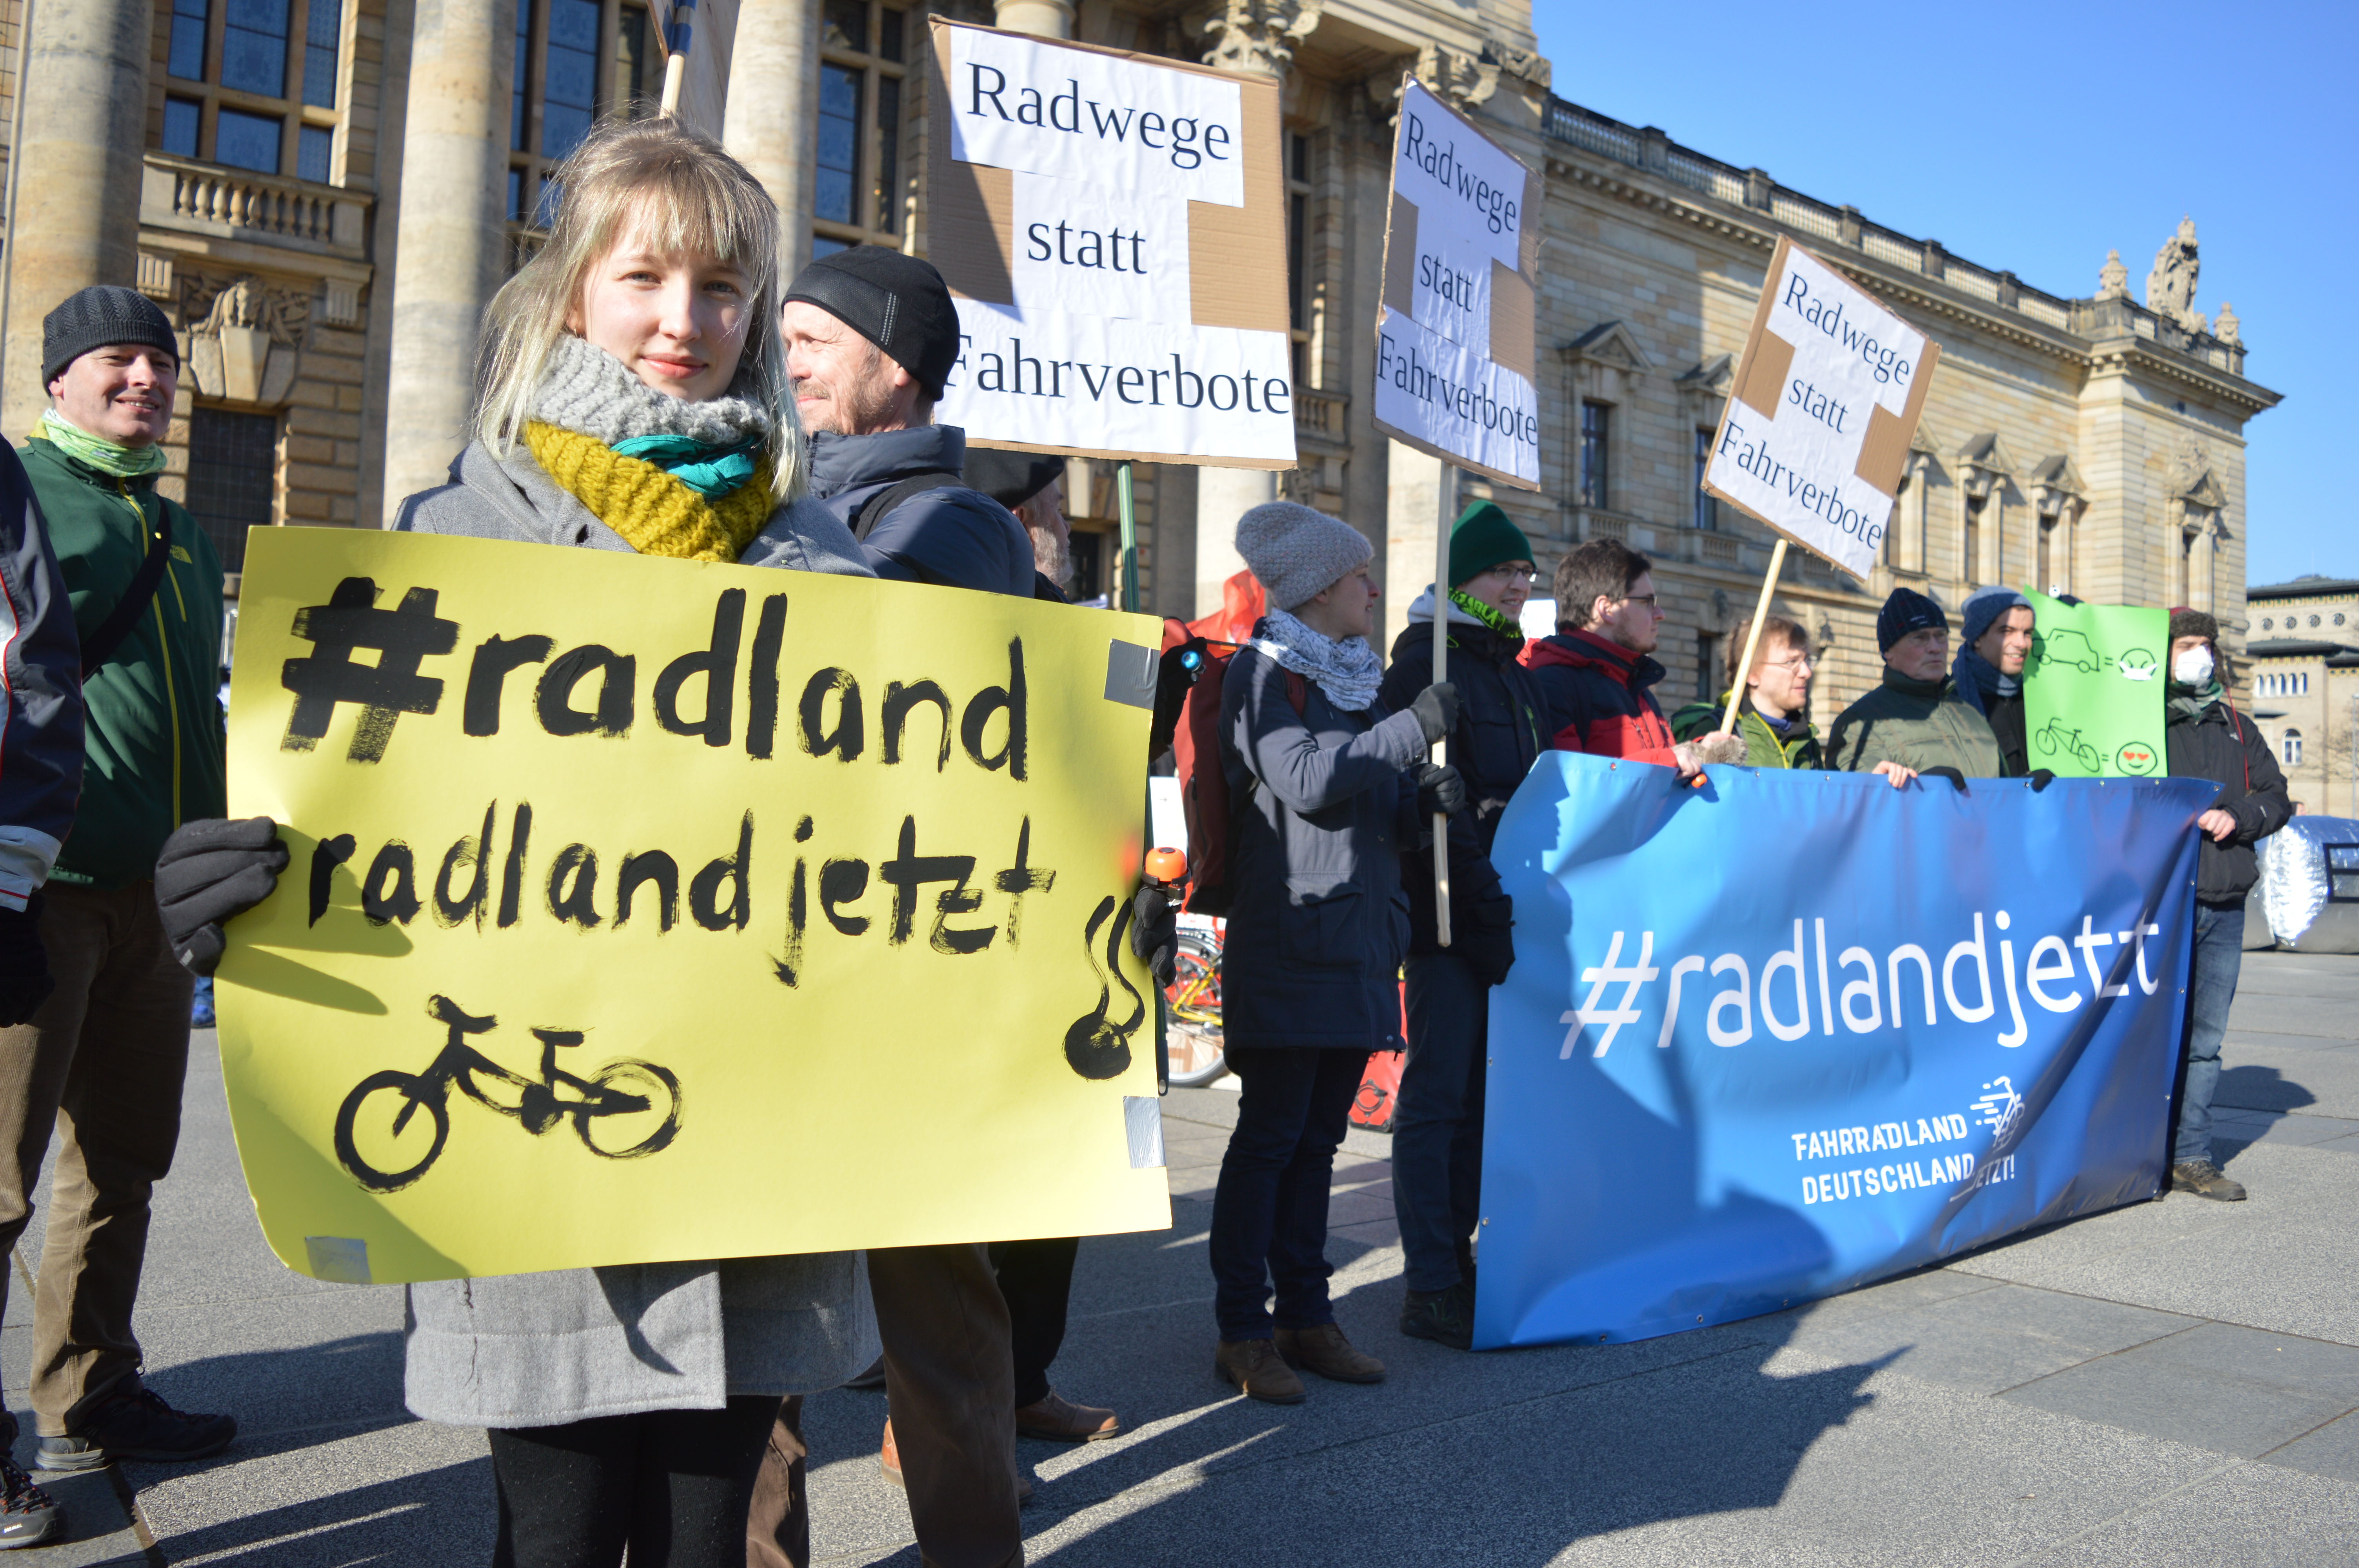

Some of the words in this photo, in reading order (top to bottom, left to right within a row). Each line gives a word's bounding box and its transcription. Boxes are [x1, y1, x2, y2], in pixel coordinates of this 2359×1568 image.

[967, 62, 1229, 169] Radwege
[1404, 111, 1517, 235] Radwege
[1028, 220, 1147, 274] statt
[1420, 254, 1472, 312] statt
[1783, 272, 1909, 385] Radwege
[1378, 331, 1538, 446] Fahrverbote
[1788, 379, 1848, 434] statt
[1717, 420, 1882, 549] Fahrverbote
[280, 576, 1027, 782] #radland
[1791, 1113, 1968, 1161] FAHRRADLAND
[1802, 1153, 1975, 1205] DEUTSCHLAND
